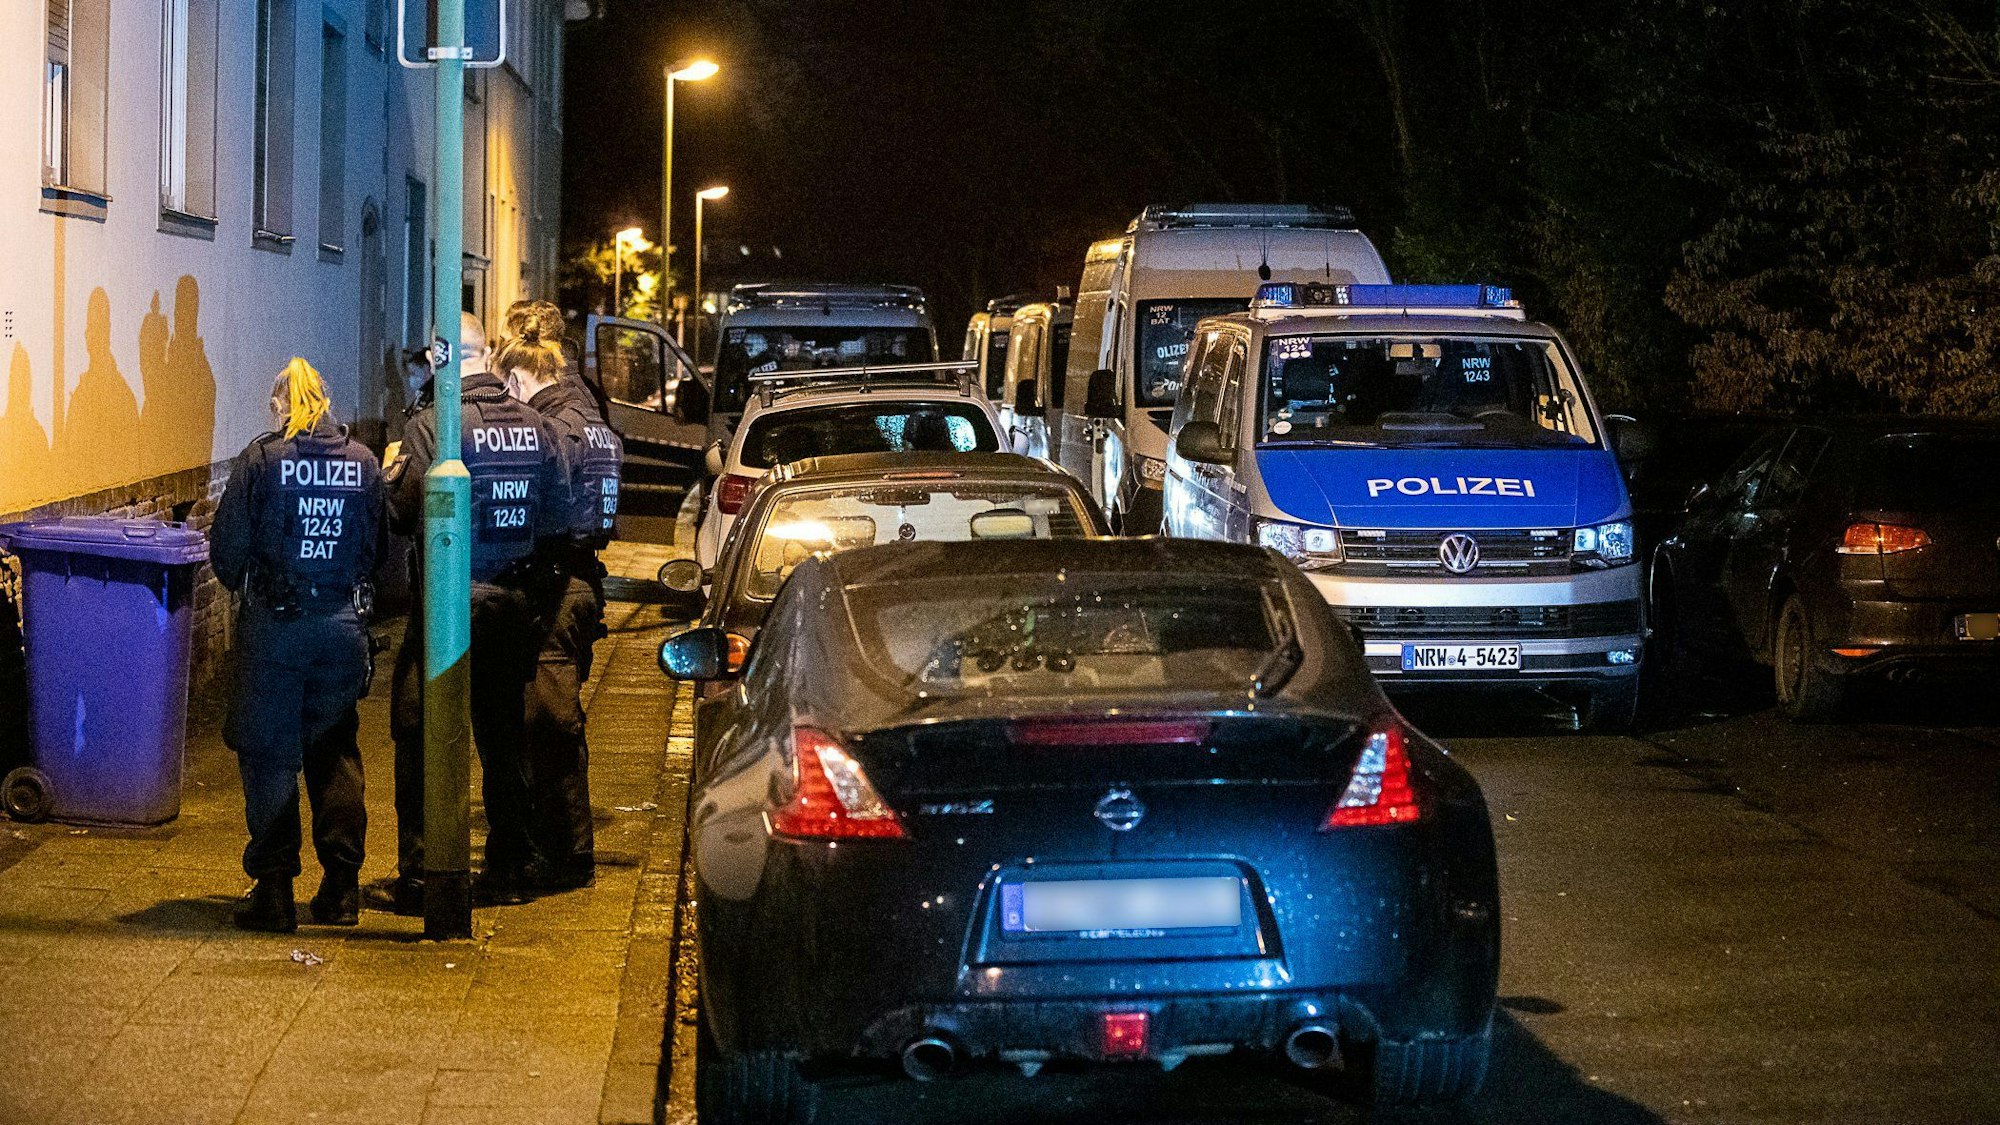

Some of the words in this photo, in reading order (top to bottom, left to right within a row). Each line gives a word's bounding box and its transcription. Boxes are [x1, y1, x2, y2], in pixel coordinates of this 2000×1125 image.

[1150, 317, 1171, 325] BAT
[1279, 337, 1310, 345] NRW
[1284, 344, 1306, 352] 124
[1462, 357, 1491, 369] NRW
[1464, 370, 1490, 382] 1243
[472, 427, 539, 453] POLIZEI
[281, 460, 361, 487] POLIZEI
[492, 480, 529, 500] NRW
[1367, 477, 1535, 498] POLIZEI
[298, 497, 345, 517] NRW
[302, 518, 342, 537] 1243
[493, 508, 526, 528] 1243
[300, 540, 338, 559] BAT
[1415, 648, 1447, 667] NRW
[1457, 647, 1518, 666] 4-5423
